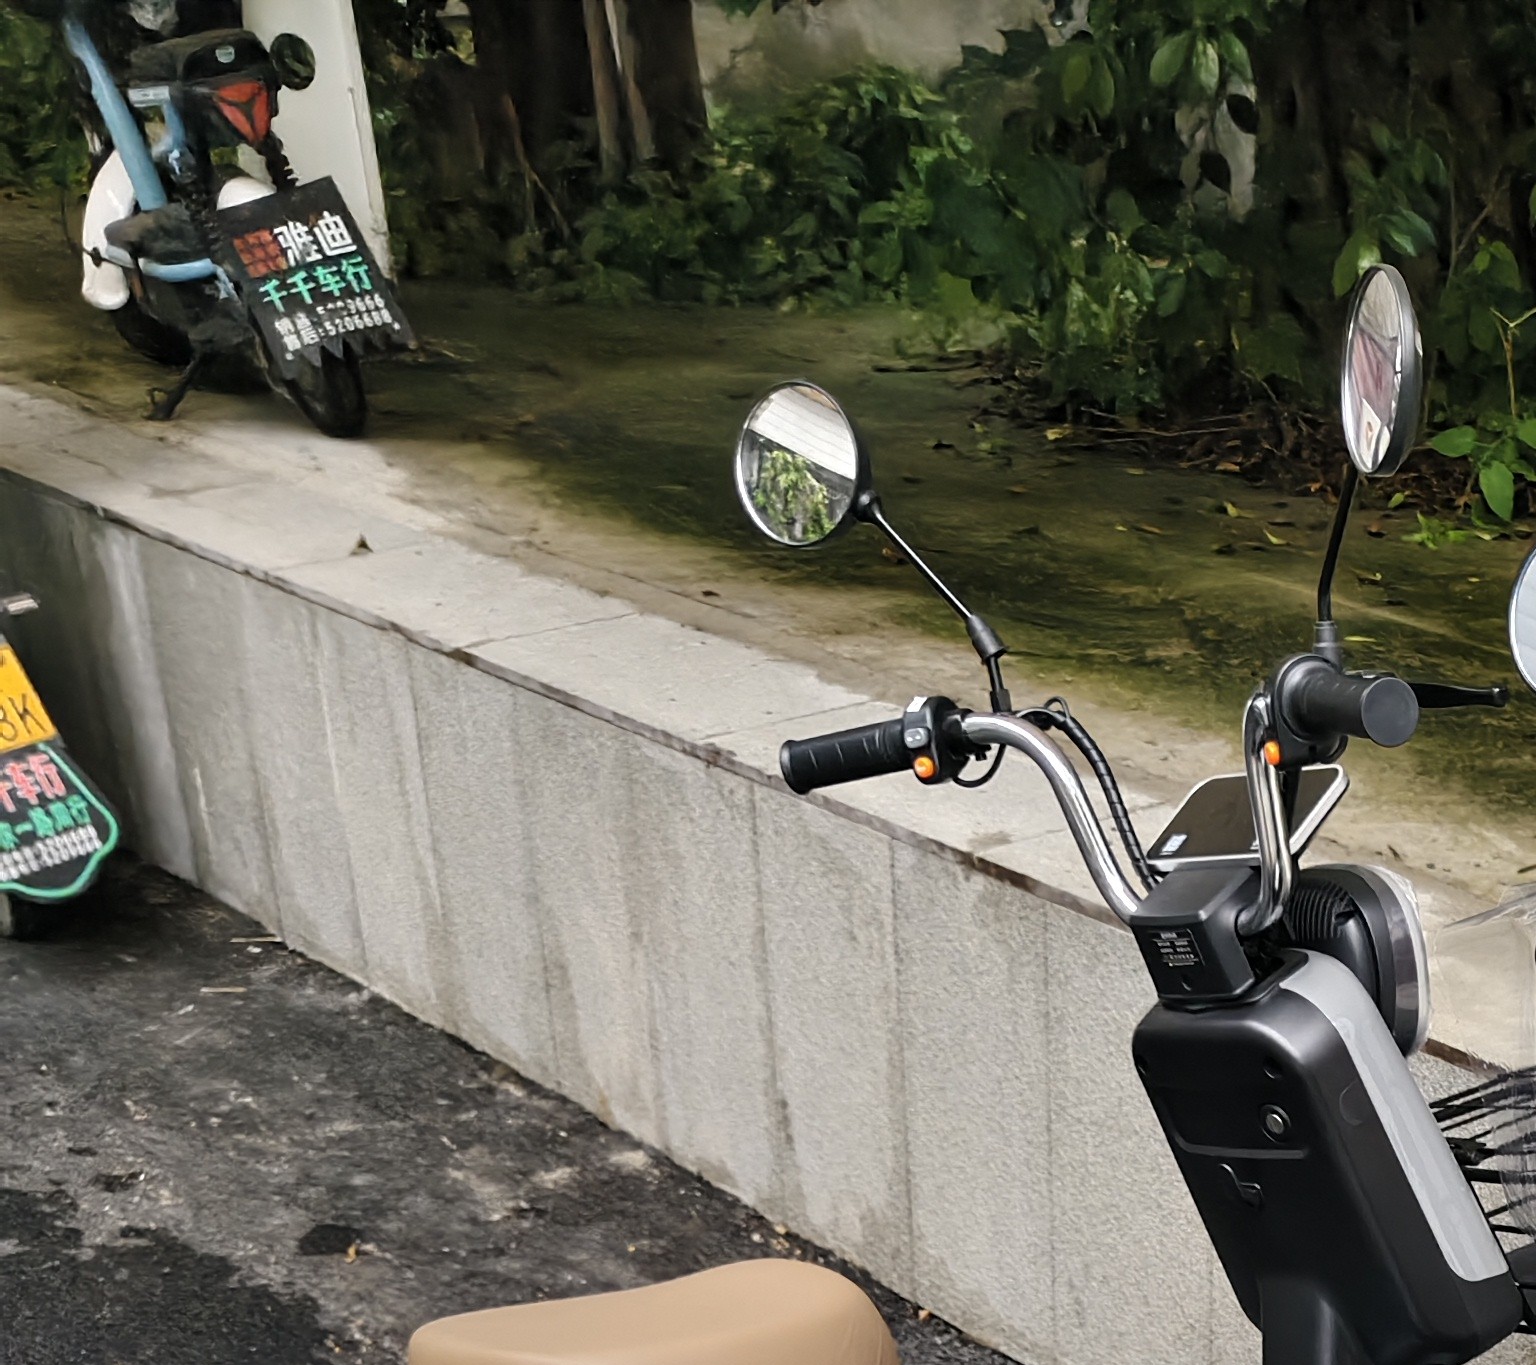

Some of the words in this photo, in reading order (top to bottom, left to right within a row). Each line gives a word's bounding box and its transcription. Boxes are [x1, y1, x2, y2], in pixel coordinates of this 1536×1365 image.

[273, 211, 357, 267] 雅迪
[259, 255, 373, 313] 千千车行
